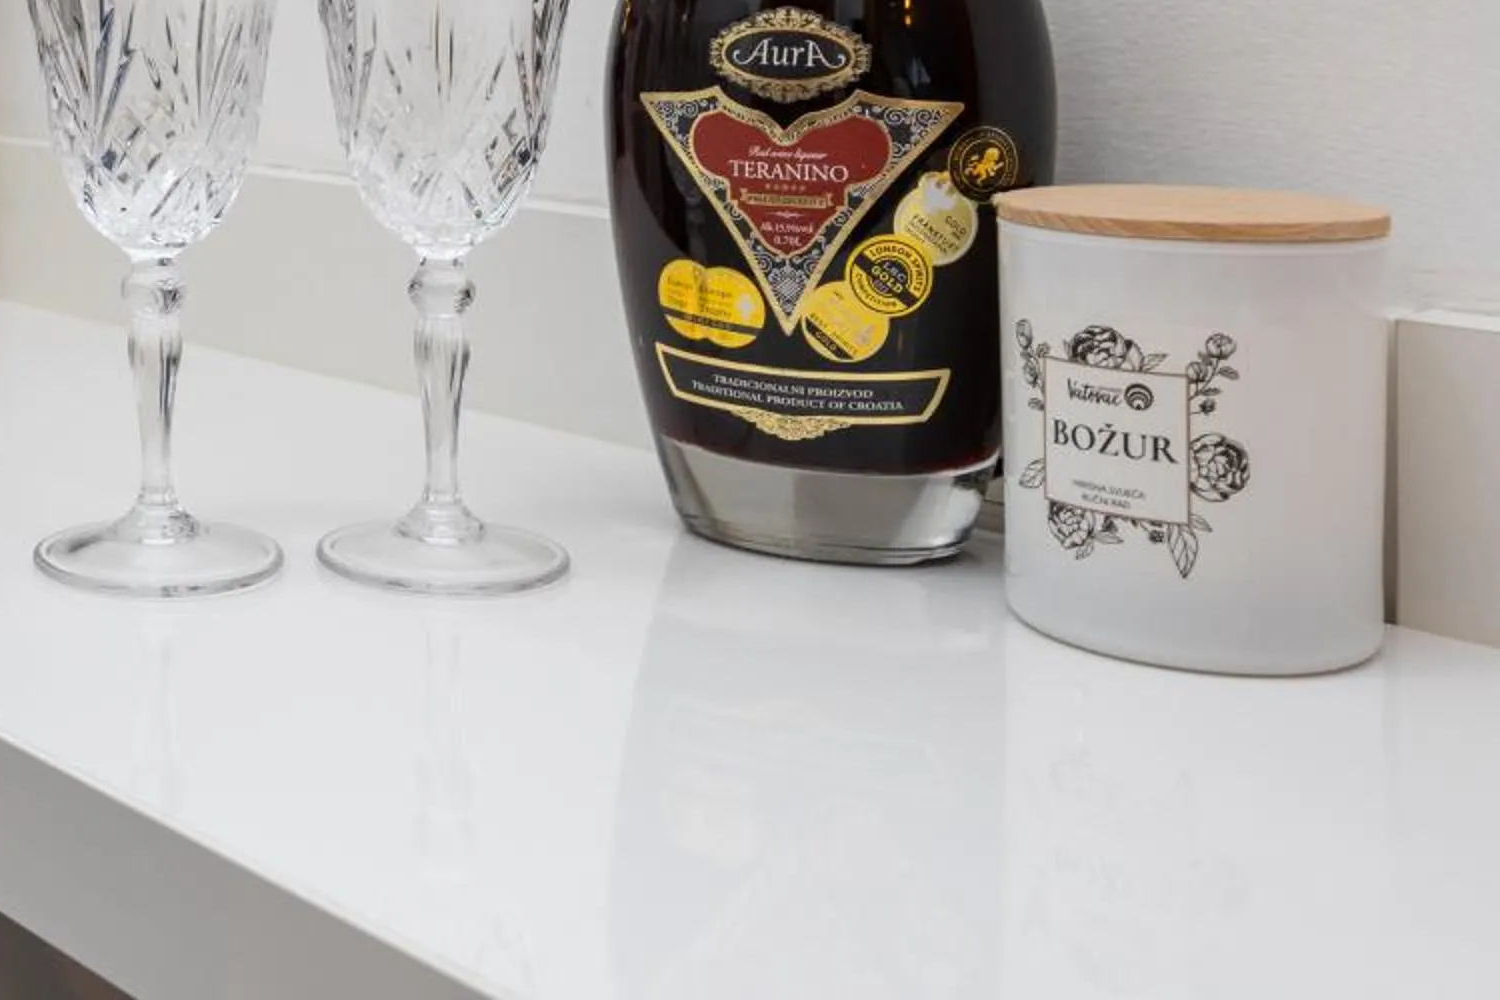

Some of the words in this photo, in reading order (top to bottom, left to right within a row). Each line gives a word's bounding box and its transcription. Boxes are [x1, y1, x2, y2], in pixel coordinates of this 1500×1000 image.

[728, 159, 849, 182] TERANINO
[869, 244, 911, 258] LONDON
[871, 265, 904, 293] GOLD
[691, 379, 764, 403] TRADITIONAL
[766, 394, 826, 409] PRODUCT
[828, 400, 847, 410] OF
[848, 401, 904, 411] CROATIA
[806, 387, 874, 399] PROIZVOD
[1052, 417, 1179, 464] BOŽUR
